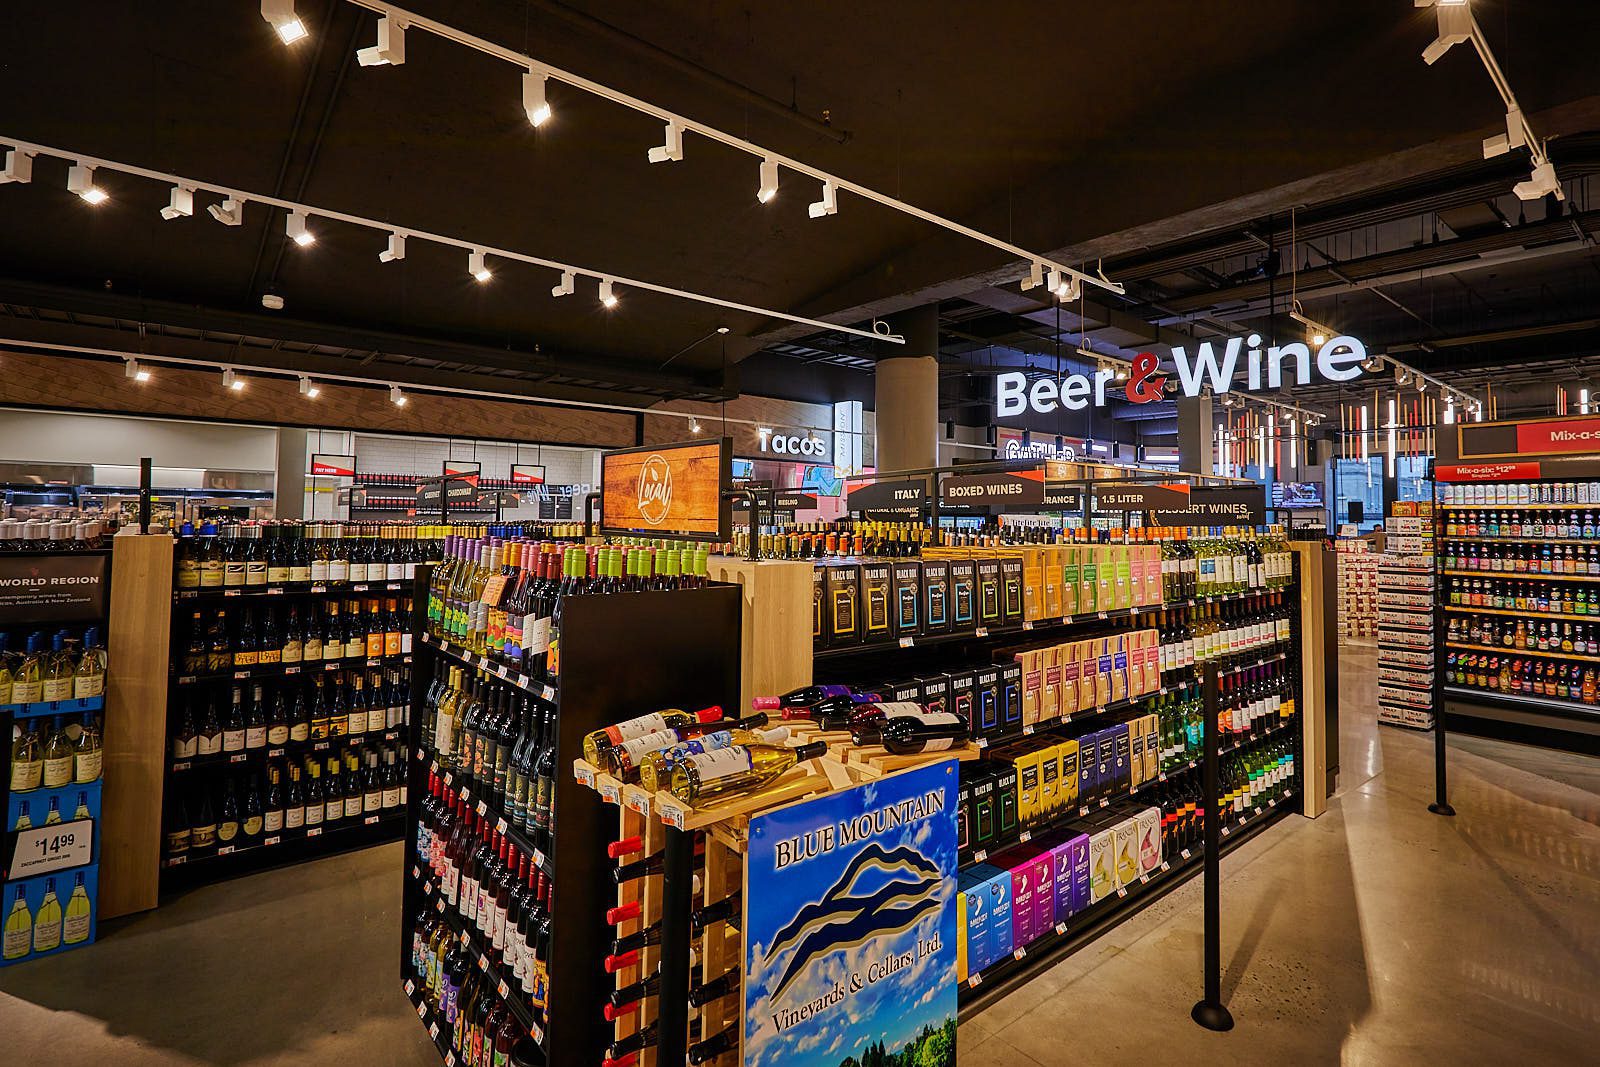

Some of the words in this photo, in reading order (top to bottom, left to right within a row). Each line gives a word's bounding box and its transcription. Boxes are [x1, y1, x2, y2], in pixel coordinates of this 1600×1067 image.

[996, 370, 1107, 418] Beer
[1125, 352, 1167, 403] &
[1171, 334, 1367, 398] Wine
[760, 427, 826, 457] Tacos
[894, 489, 920, 500] ITALY
[949, 485, 984, 498] BOXED
[986, 483, 1023, 496] WINES
[1101, 494, 1116, 504] 1.5
[1117, 494, 1144, 503] LITER
[1208, 503, 1248, 514] WINES
[0, 578, 47, 586] WORLD
[50, 576, 99, 585] REGION
[775, 826, 835, 869] BLUE
[839, 789, 945, 846] MOUNTAIN
[771, 984, 845, 1034] Vineyards
[849, 973, 864, 994] &
[867, 950, 914, 983] Cellars,
[918, 933, 942, 959] Ltd.
